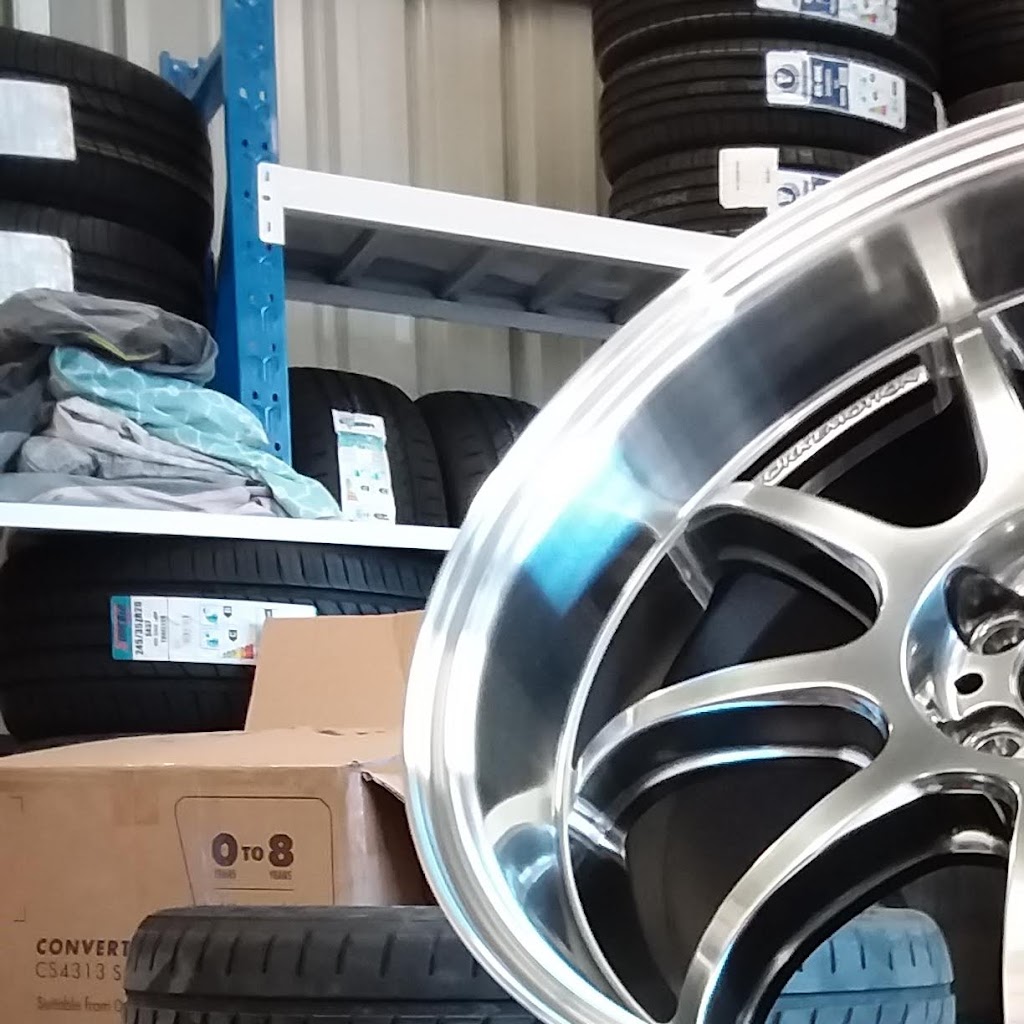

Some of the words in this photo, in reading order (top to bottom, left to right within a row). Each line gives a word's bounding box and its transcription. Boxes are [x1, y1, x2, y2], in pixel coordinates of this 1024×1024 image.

[212, 833, 238, 867] 0
[241, 846, 264, 861] TO
[268, 833, 294, 867] 8
[36, 961, 105, 980] CS4313
